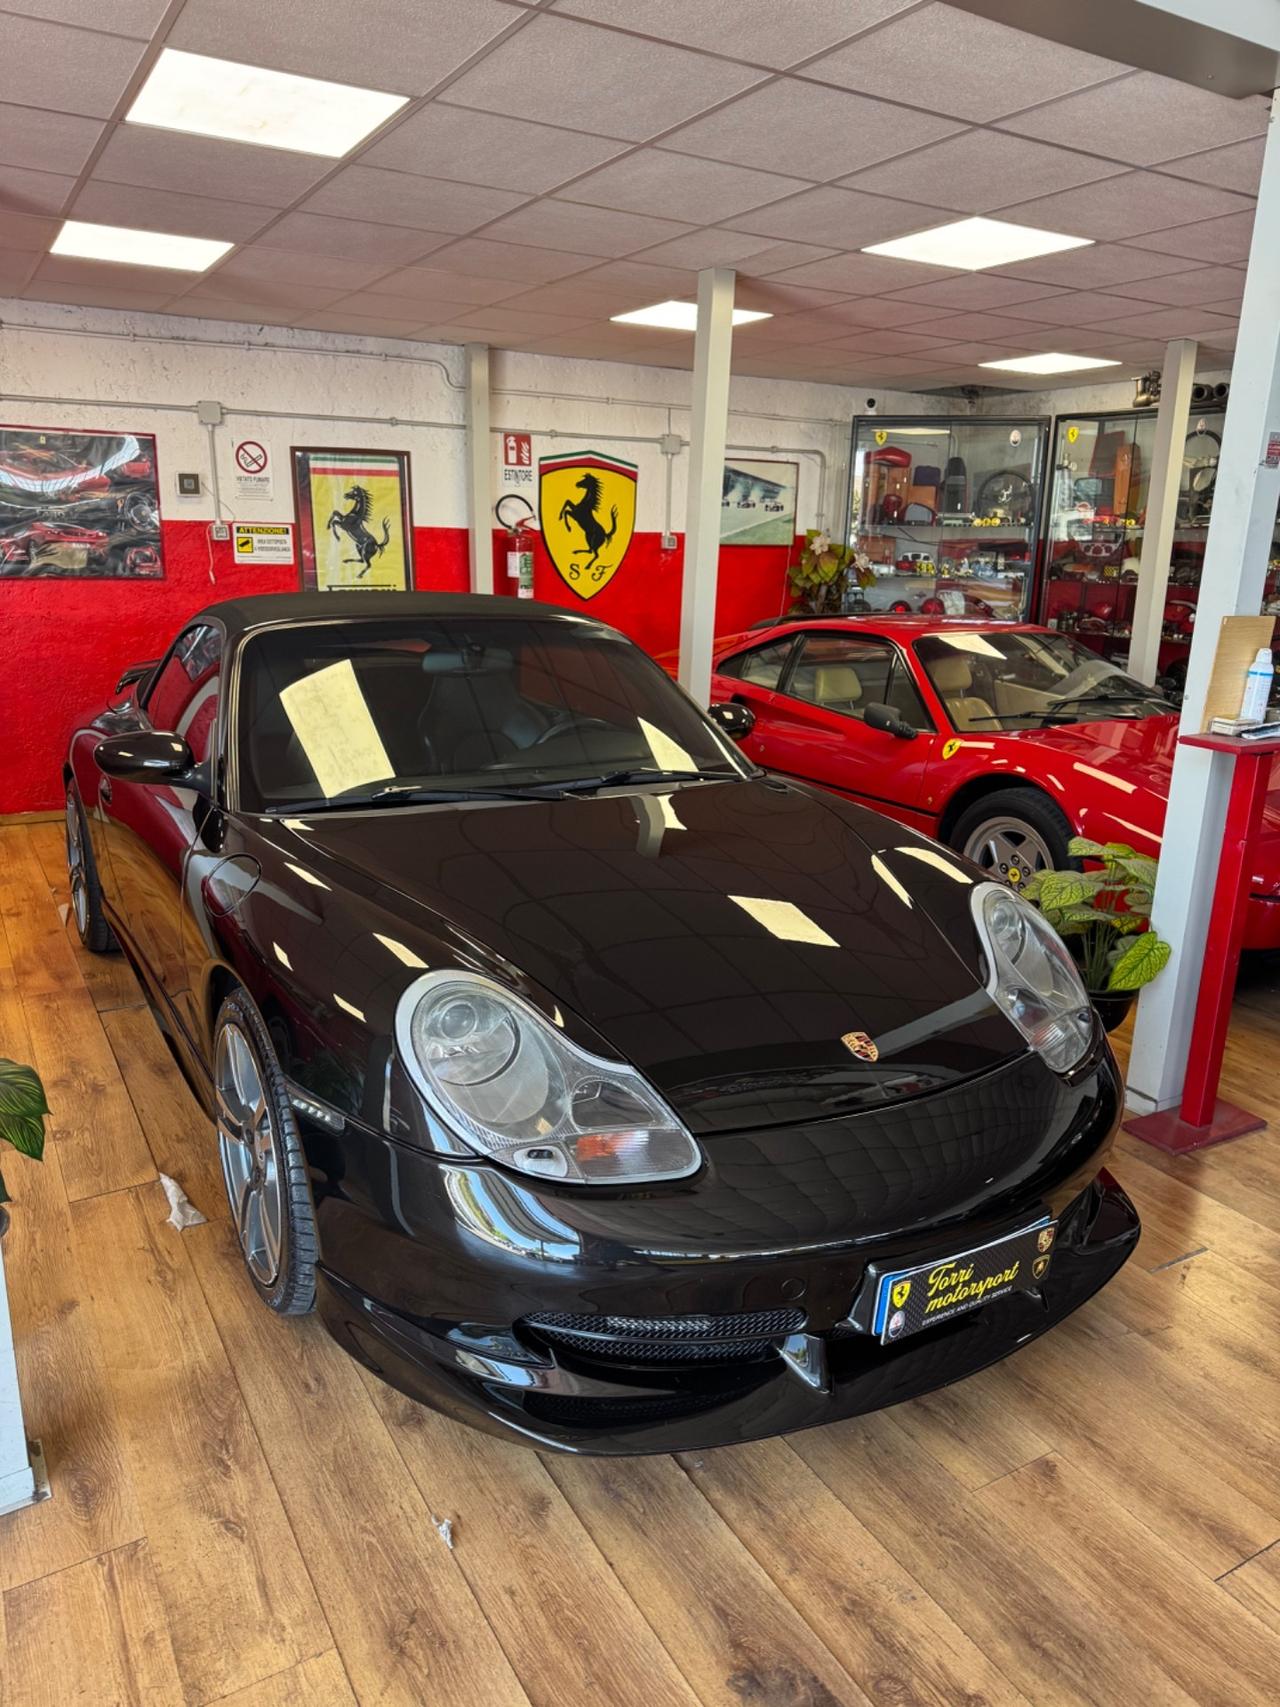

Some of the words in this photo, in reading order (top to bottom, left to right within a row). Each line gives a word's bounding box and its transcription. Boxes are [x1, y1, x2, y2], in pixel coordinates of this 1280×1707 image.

[569, 563, 580, 580] S
[591, 564, 614, 582] F
[924, 1261, 1020, 1314] motorsport
[927, 1261, 975, 1297] Torri
